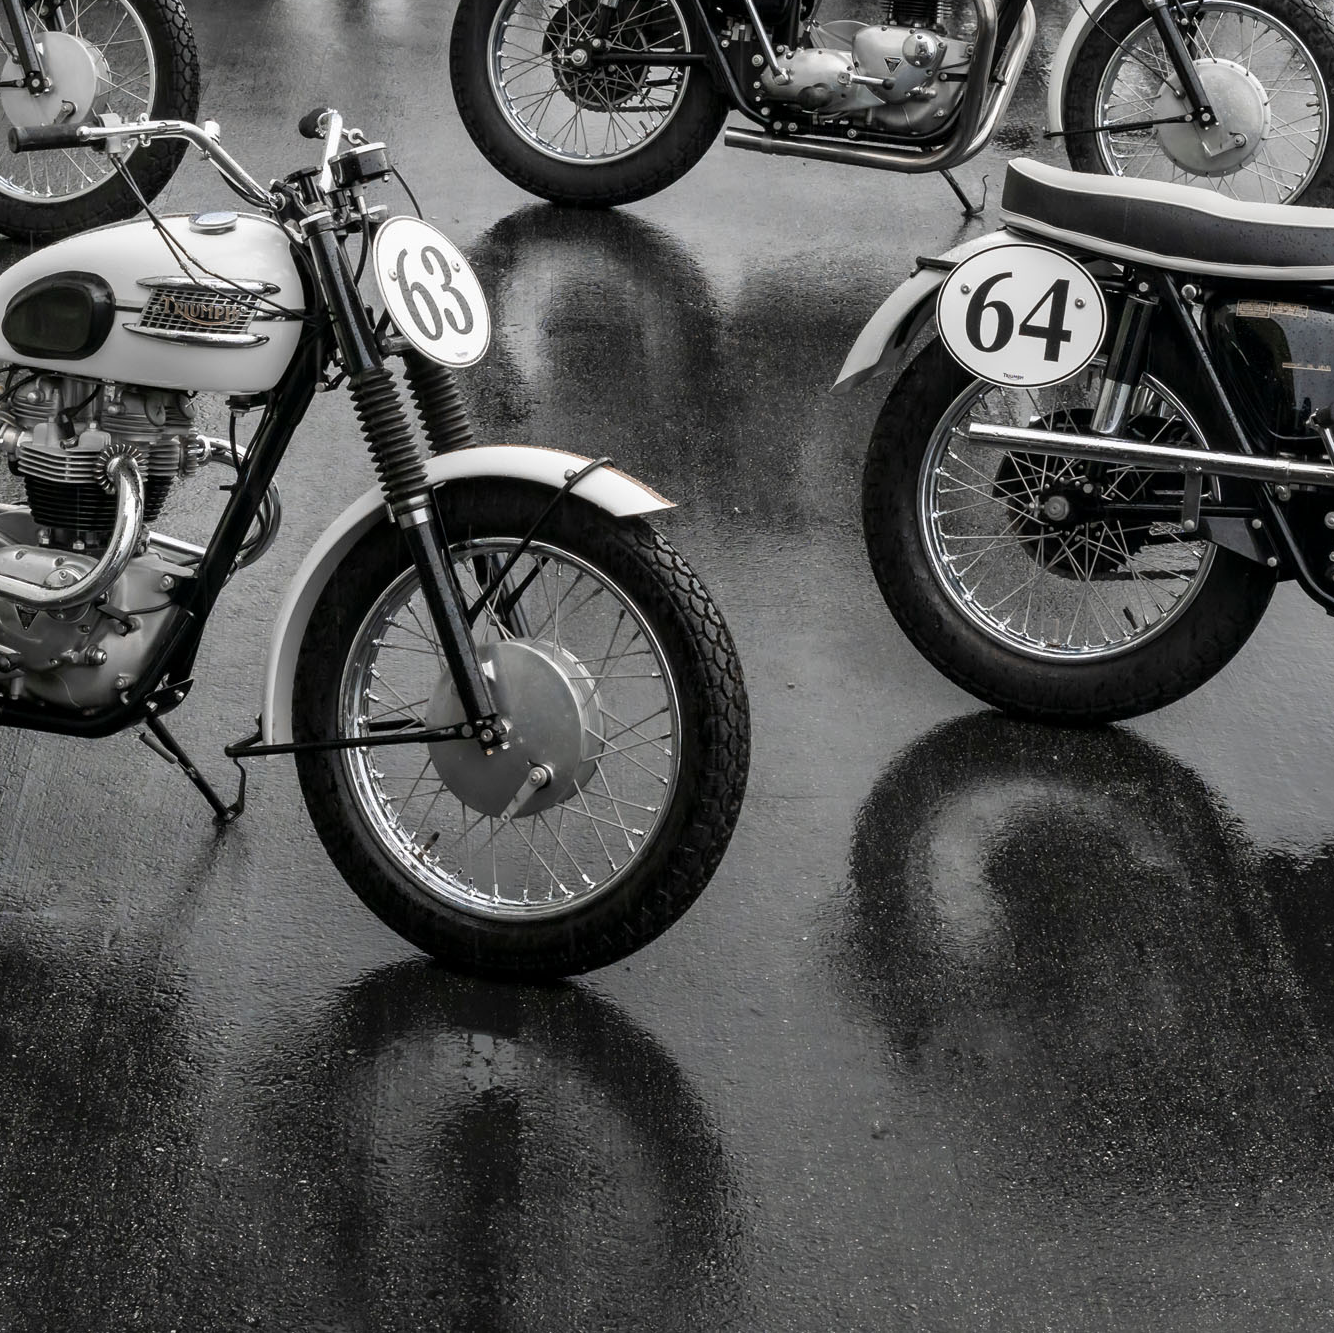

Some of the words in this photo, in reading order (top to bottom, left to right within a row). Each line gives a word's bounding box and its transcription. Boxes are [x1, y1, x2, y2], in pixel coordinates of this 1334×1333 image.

[161, 296, 240, 325] TRIUMPH
[396, 246, 471, 341] 63
[966, 272, 1072, 363] 64
